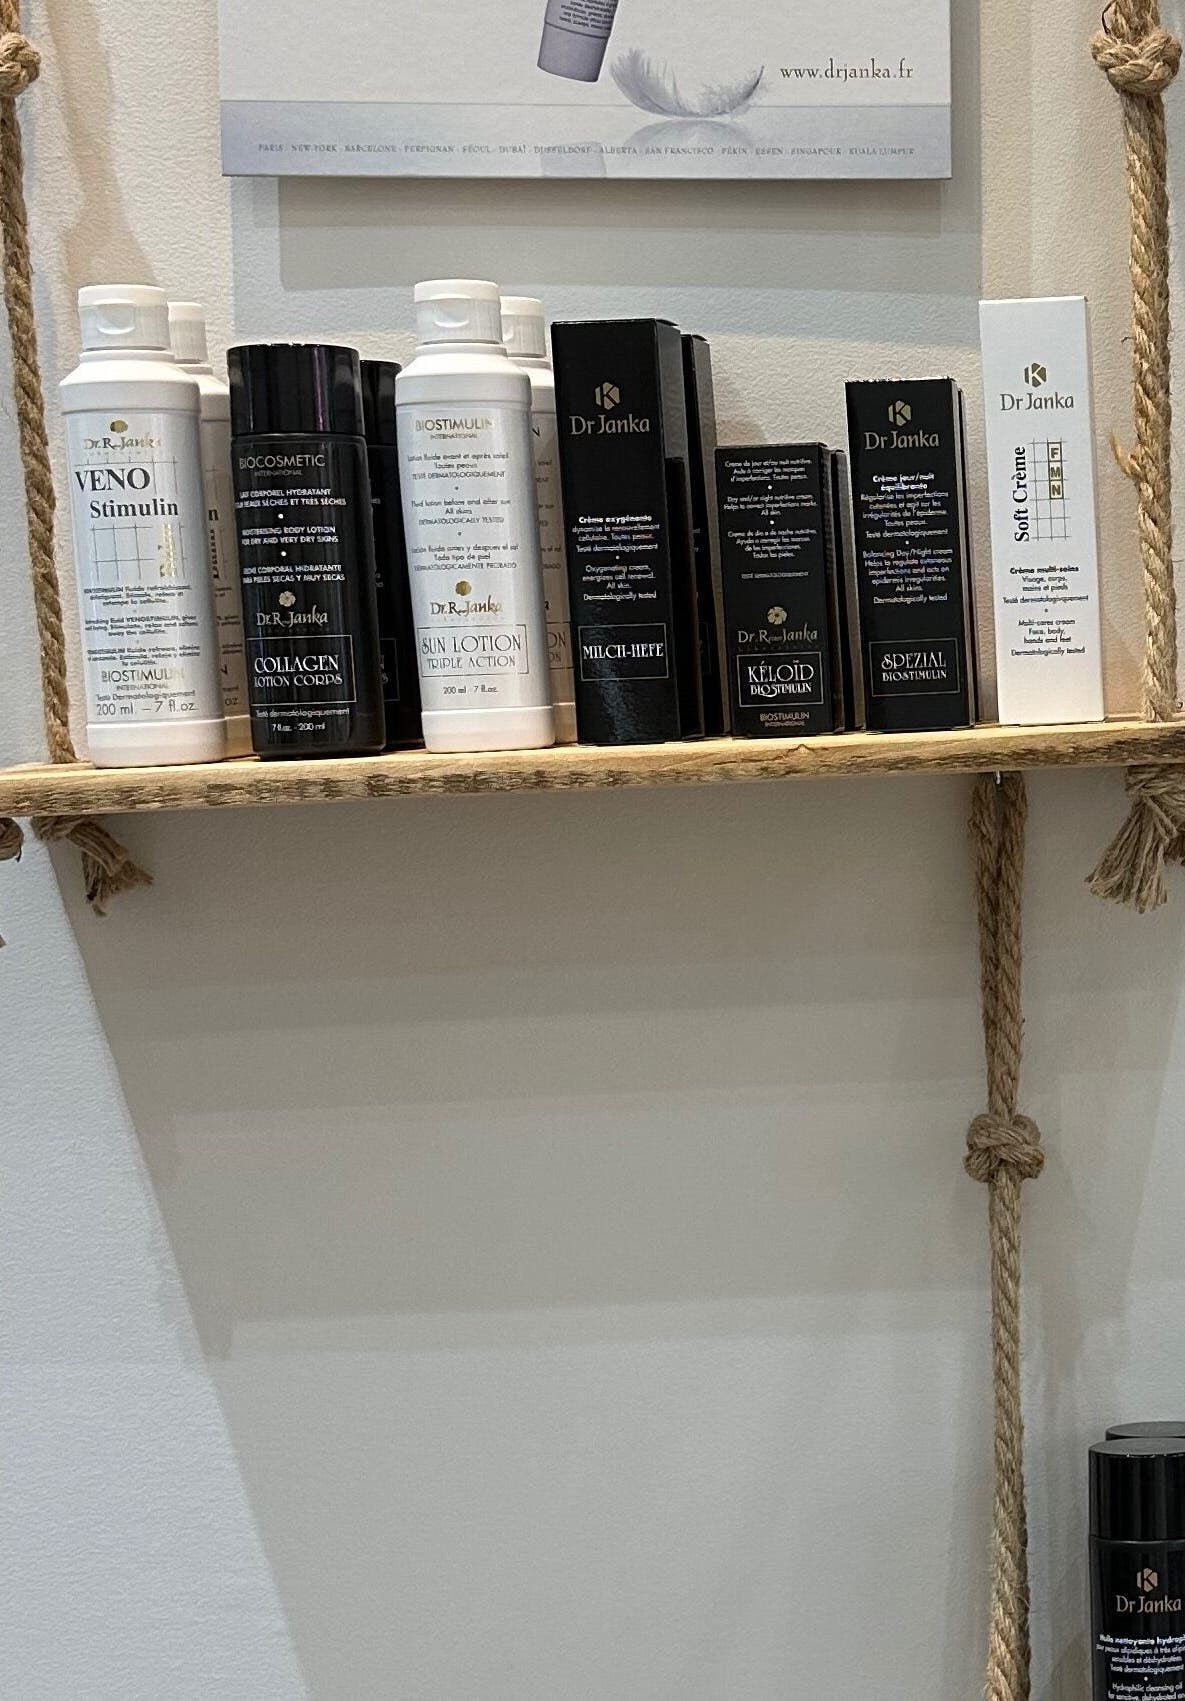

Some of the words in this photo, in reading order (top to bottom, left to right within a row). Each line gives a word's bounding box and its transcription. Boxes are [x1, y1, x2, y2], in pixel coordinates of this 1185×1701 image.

[780, 58, 913, 82] www.drjanka.fr
[240, 454, 325, 469] BIOCOSMETIC
[74, 468, 150, 492] VENO
[1011, 446, 1028, 503] Crème
[90, 498, 179, 519] Stimulin
[1014, 508, 1029, 542] Soft
[422, 637, 445, 654] SUN
[452, 634, 521, 653] LOTION
[583, 643, 664, 659] MILCH-HEFE
[254, 655, 339, 673] COLLAGEN
[428, 657, 462, 670] TRIPLE
[469, 655, 516, 667] ACTION
[881, 652, 947, 670] SPEZIAL
[748, 660, 814, 683] KÉLOÏD
[882, 670, 947, 682] BIOSTIMULIN
[254, 676, 290, 688] LOTION
[294, 674, 343, 686] CORPS
[443, 686, 456, 694] 200
[751, 683, 812, 698] BIOSTIMULIN
[96, 703, 116, 715] 200
[120, 704, 133, 714] ml
[155, 701, 163, 712] 7
